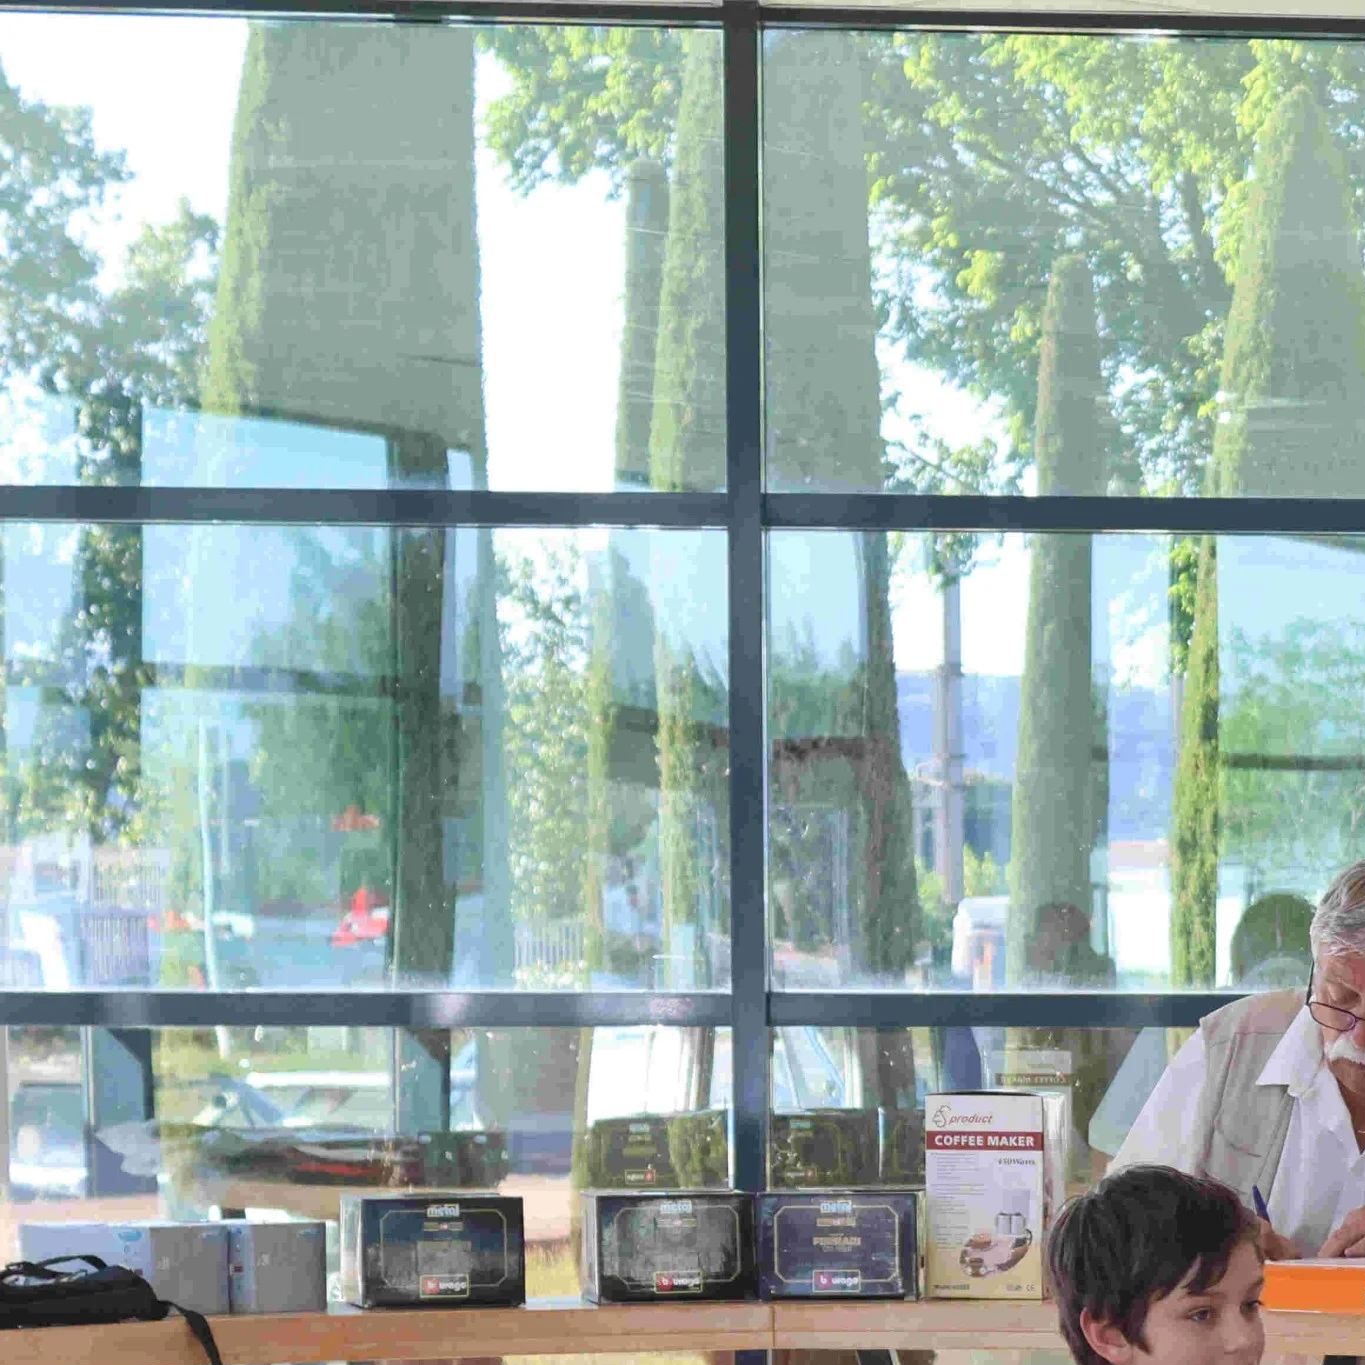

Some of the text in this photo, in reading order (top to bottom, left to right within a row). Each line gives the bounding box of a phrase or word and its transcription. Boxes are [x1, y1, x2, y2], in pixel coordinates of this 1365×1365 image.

[949, 1113, 993, 1126] product
[934, 1135, 1035, 1147] COFFEE MAKER
